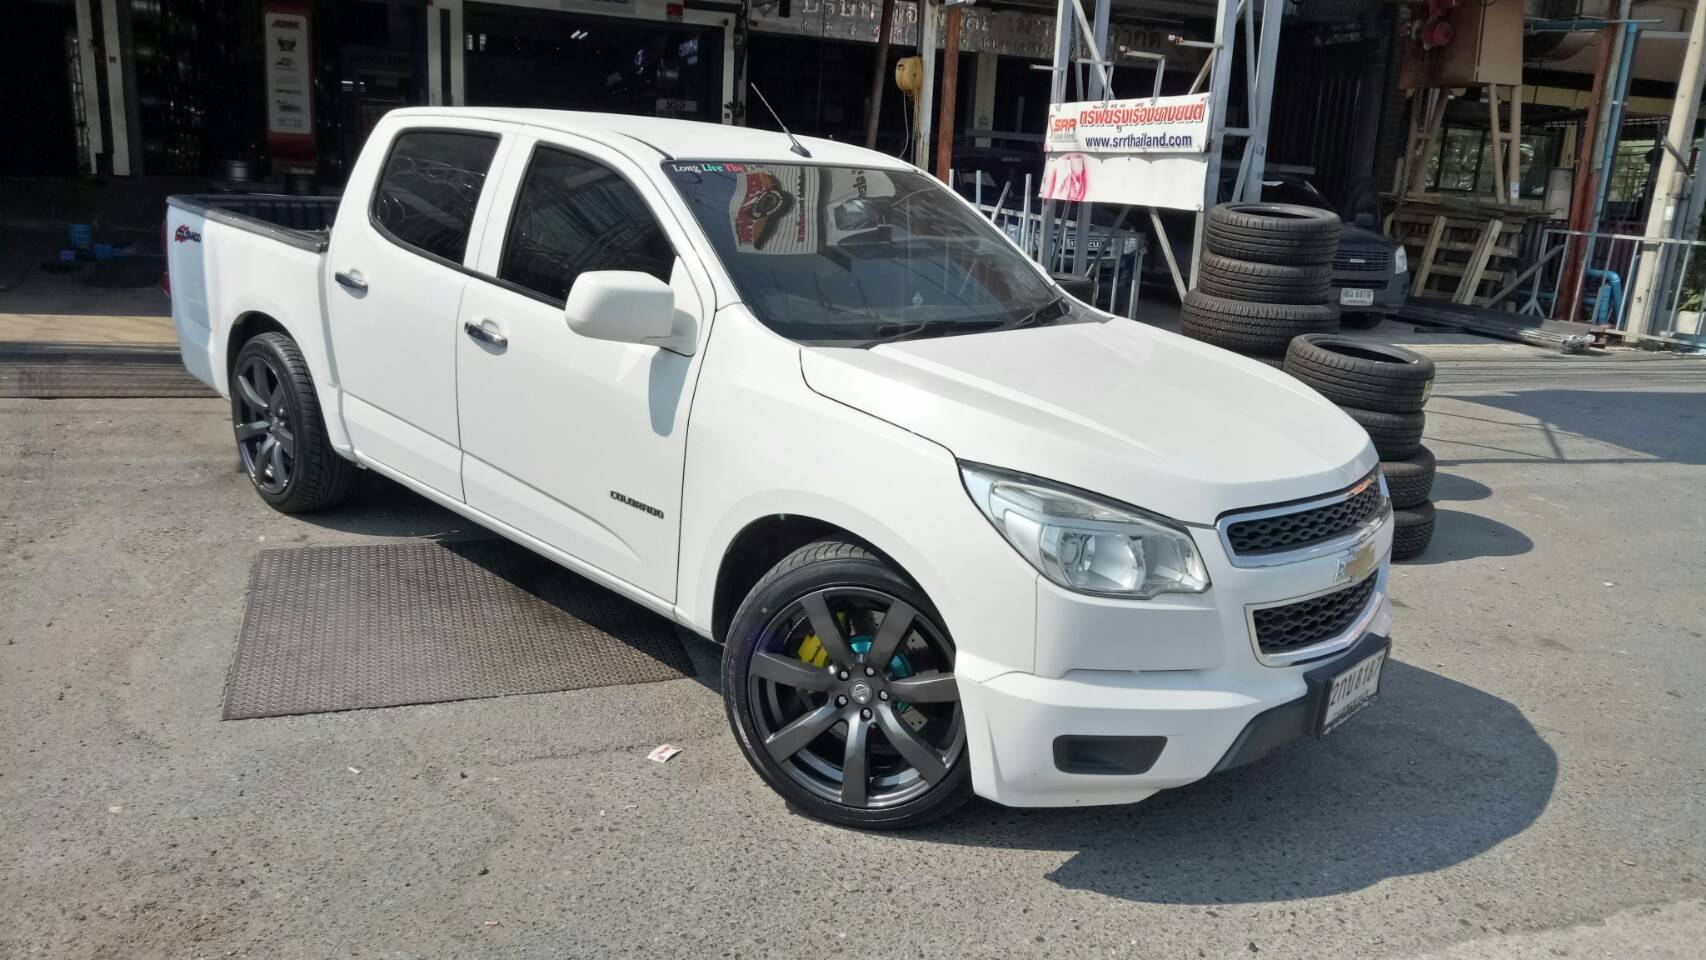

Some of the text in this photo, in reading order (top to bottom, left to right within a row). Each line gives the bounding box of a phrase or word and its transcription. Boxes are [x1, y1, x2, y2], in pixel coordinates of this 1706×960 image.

[1085, 133, 1192, 148] www.srrthailand.com
[672, 164, 702, 174] Long
[703, 163, 724, 172] Live
[610, 490, 665, 520] COLORADO
